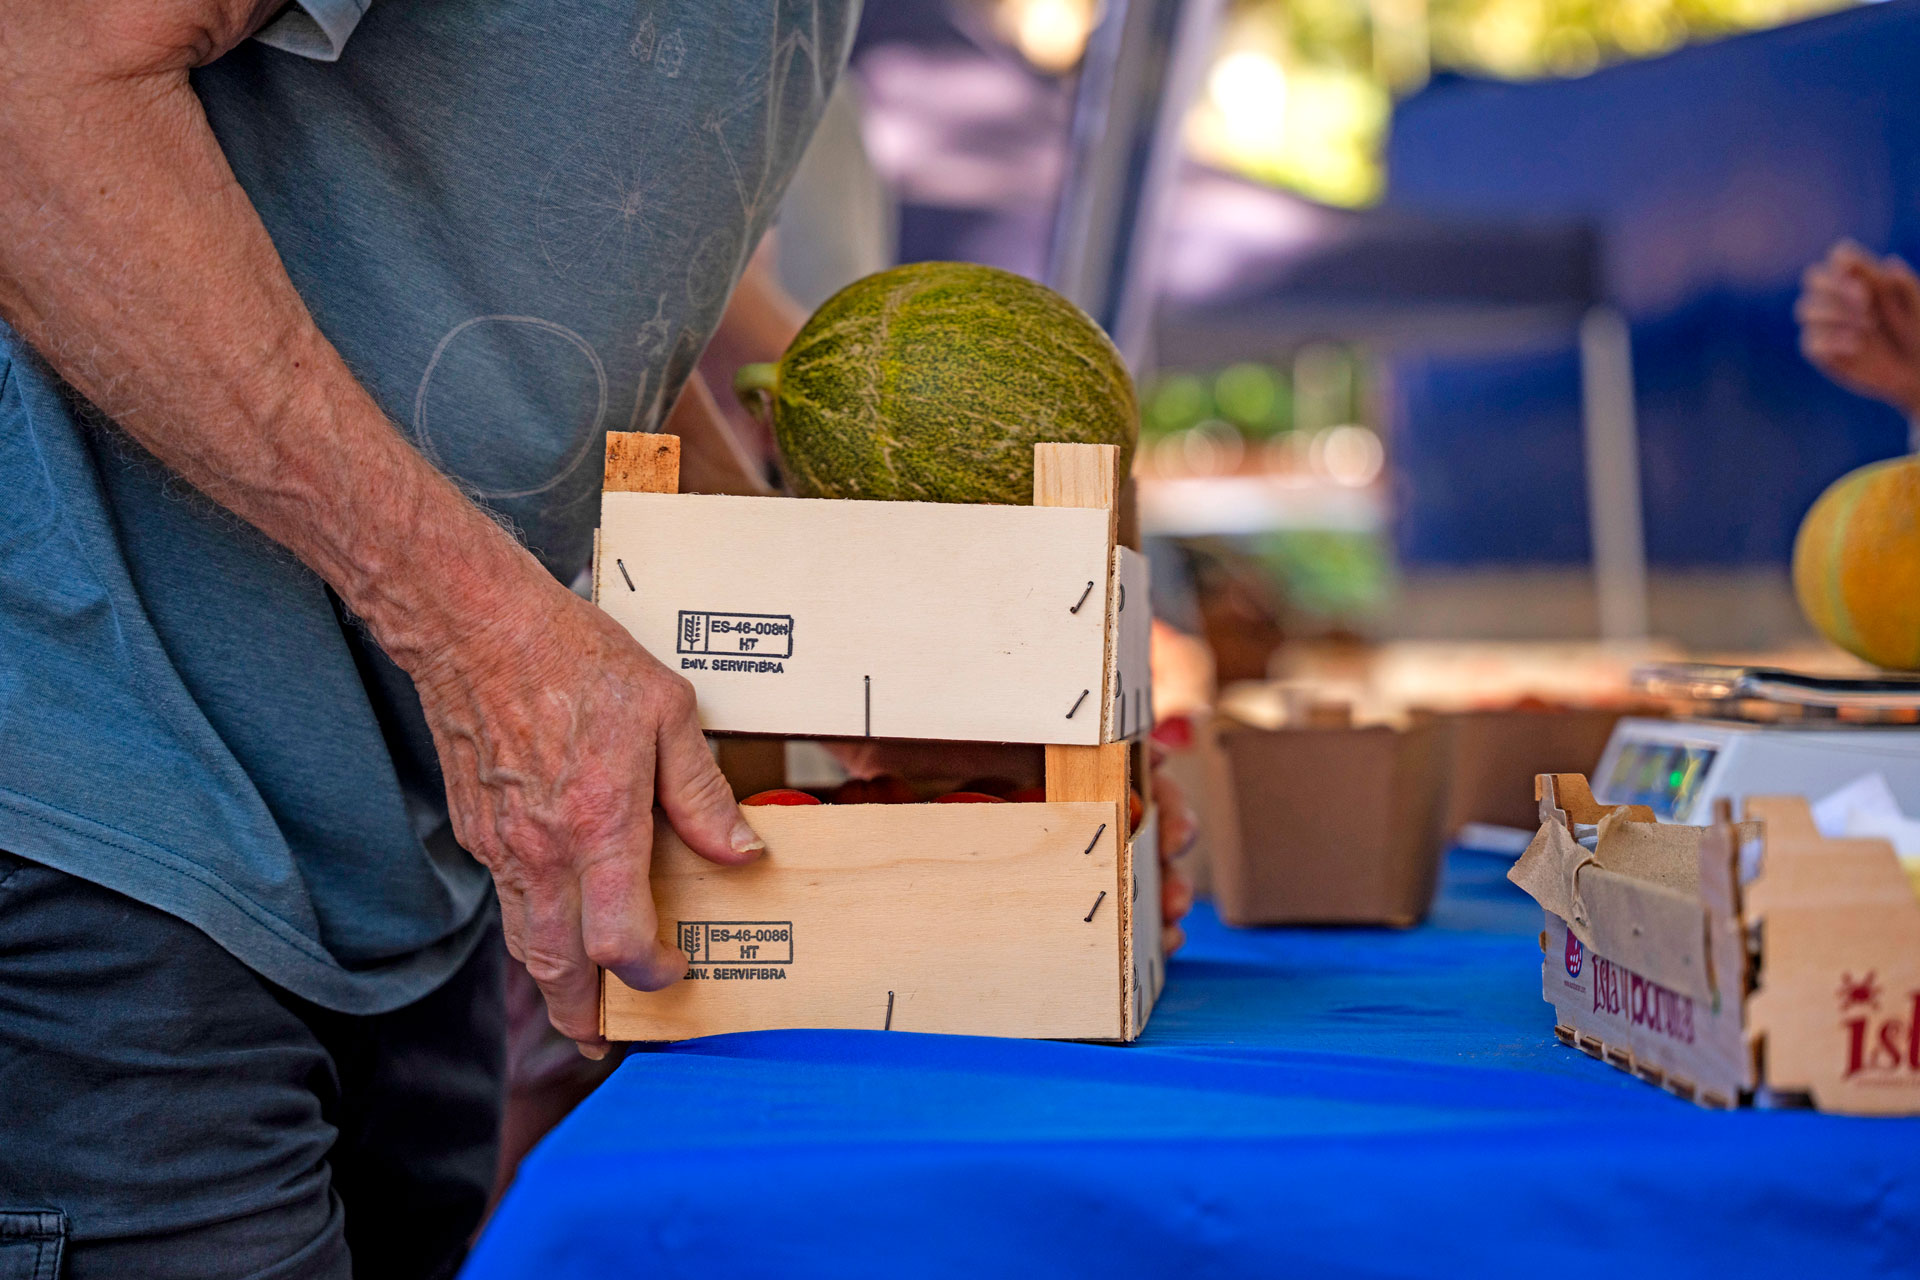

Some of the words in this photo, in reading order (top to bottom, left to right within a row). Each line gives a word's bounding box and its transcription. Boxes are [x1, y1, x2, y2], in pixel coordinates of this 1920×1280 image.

[739, 637, 759, 651] HT
[711, 658, 785, 674] SERVIFIBRA
[710, 929, 789, 942] ES-46-0086
[739, 945, 760, 959] HT
[712, 968, 787, 980] SERVIFIBRA
